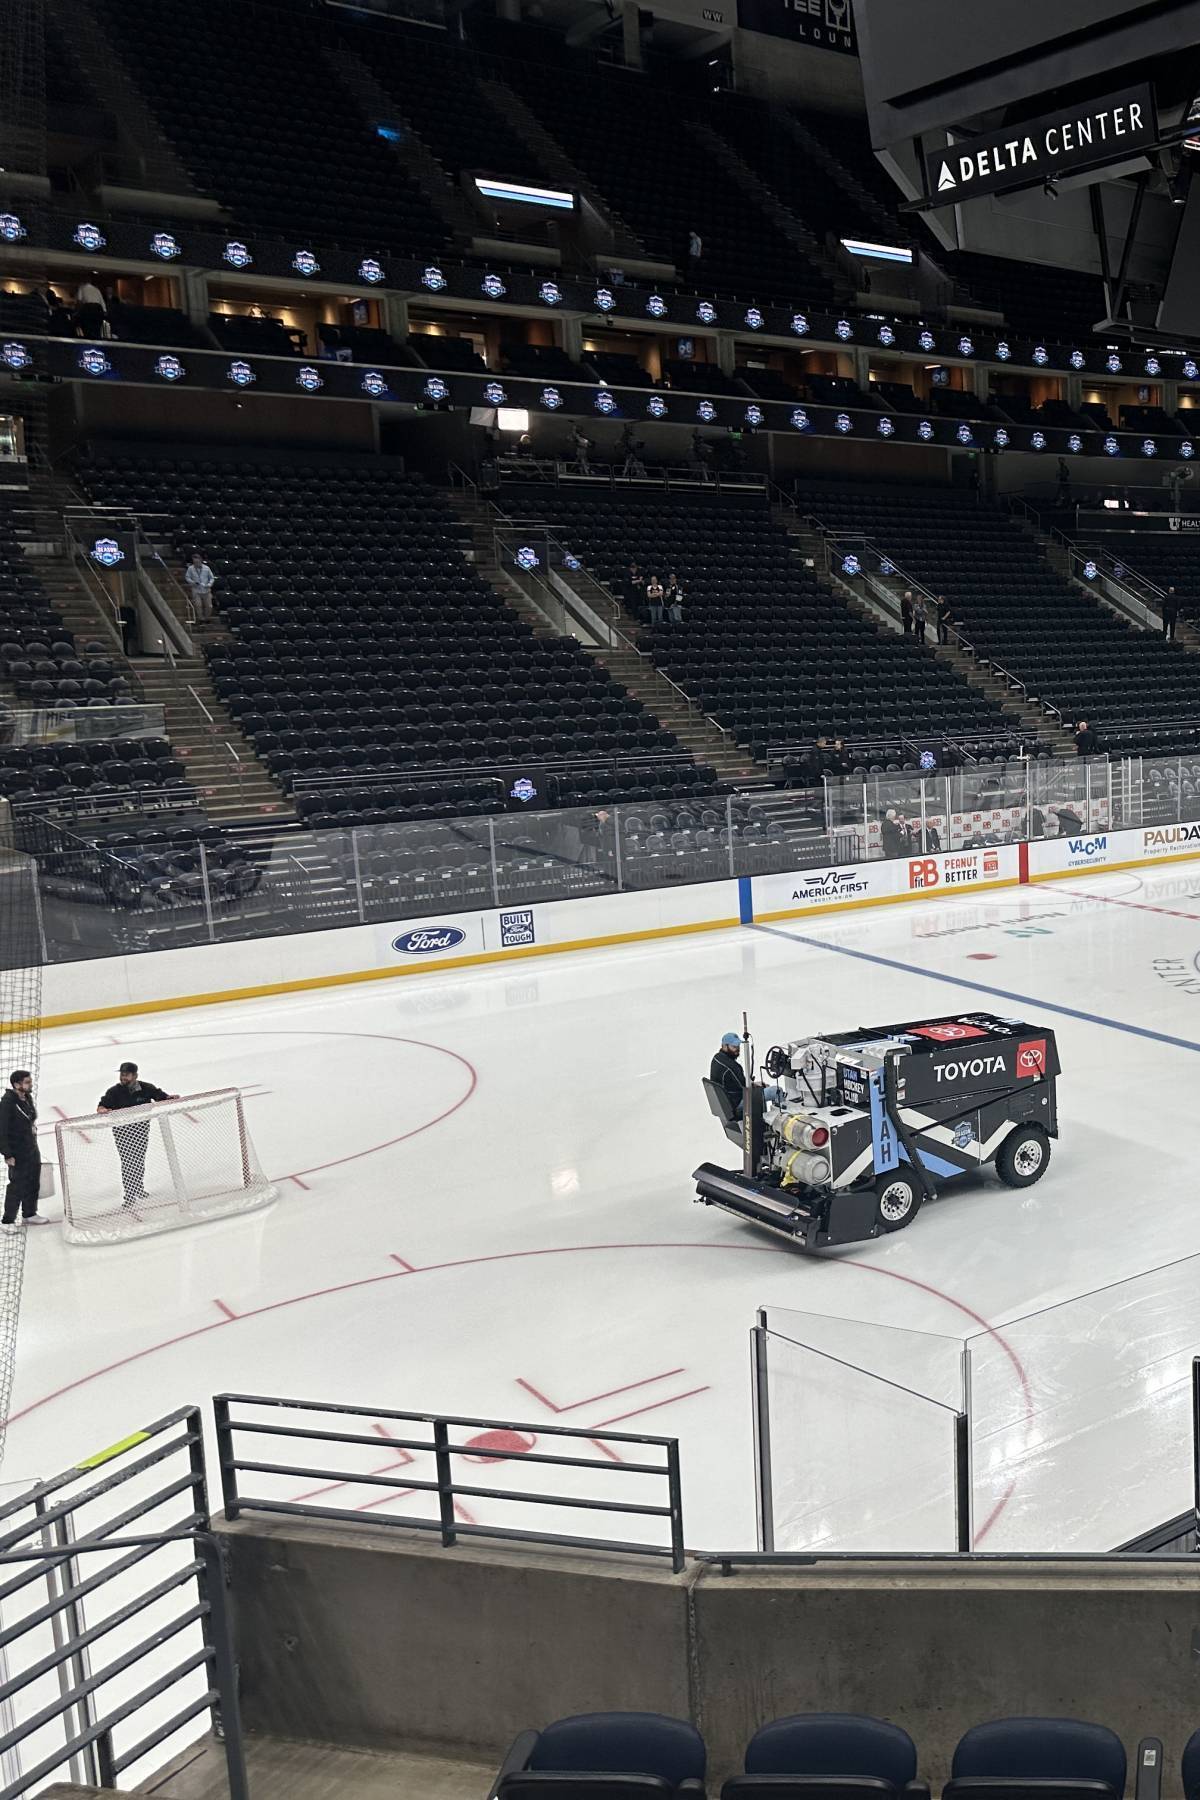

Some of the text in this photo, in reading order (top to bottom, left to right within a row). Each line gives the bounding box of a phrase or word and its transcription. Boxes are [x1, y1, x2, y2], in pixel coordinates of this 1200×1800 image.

[959, 103, 1144, 182] DELTA CENTER
[944, 856, 978, 870] PEANUT
[944, 869, 978, 883] BETTER
[791, 881, 869, 900] AMERICA FIRST
[503, 913, 530, 926] BUILT
[406, 930, 452, 951] Ford
[504, 934, 531, 943] TOUGH
[934, 1056, 1006, 1082] TOYOTA
[843, 1079, 865, 1094] HOCKEY
[844, 1092, 859, 1103] CLUB
